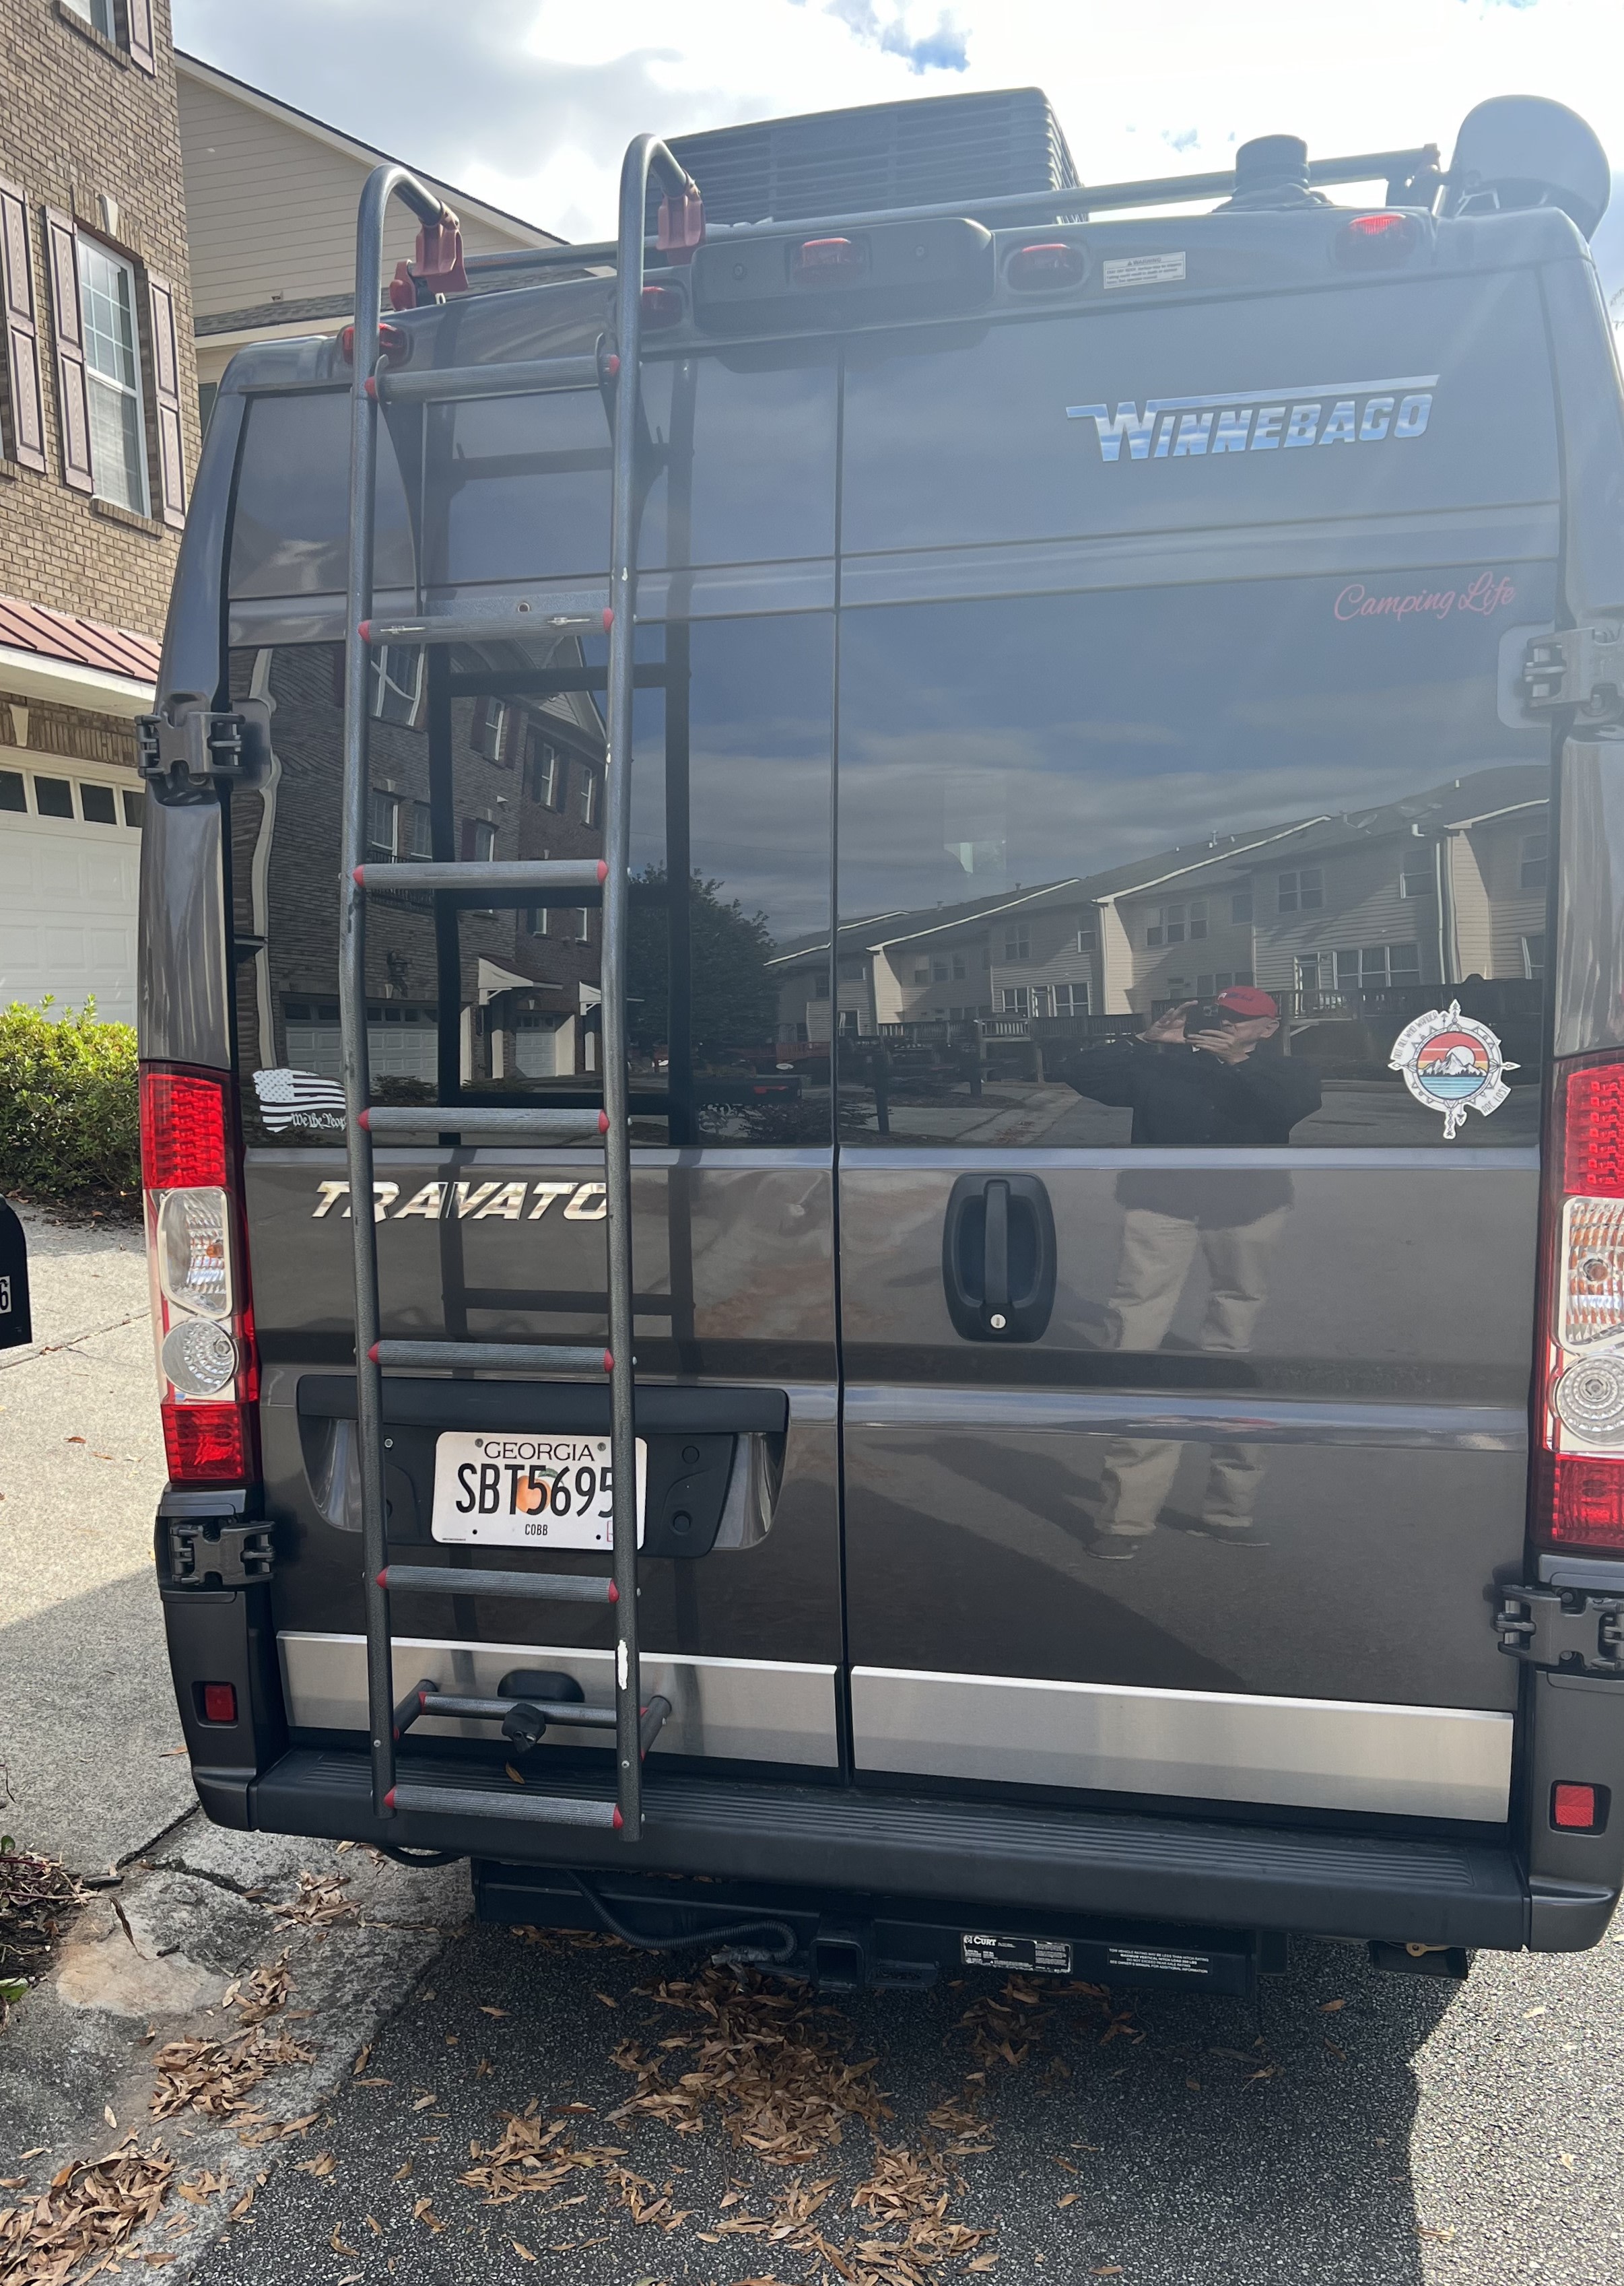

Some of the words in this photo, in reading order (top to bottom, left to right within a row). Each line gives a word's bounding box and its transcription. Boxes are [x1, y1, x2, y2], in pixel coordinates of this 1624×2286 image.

[1067, 389, 1434, 462] WINNEBAGO
[1334, 584, 1456, 621] Camping
[1458, 571, 1516, 615] Life
[1481, 1101, 1495, 1113] ARE
[1493, 1085, 1509, 1102] LOST
[310, 1180, 606, 1223] TRAVATO
[484, 1441, 595, 1463] GEORGIA
[455, 1463, 613, 1518] SBT5695
[525, 1524, 549, 1536] COBB
[974, 1937, 997, 1947] CURT
